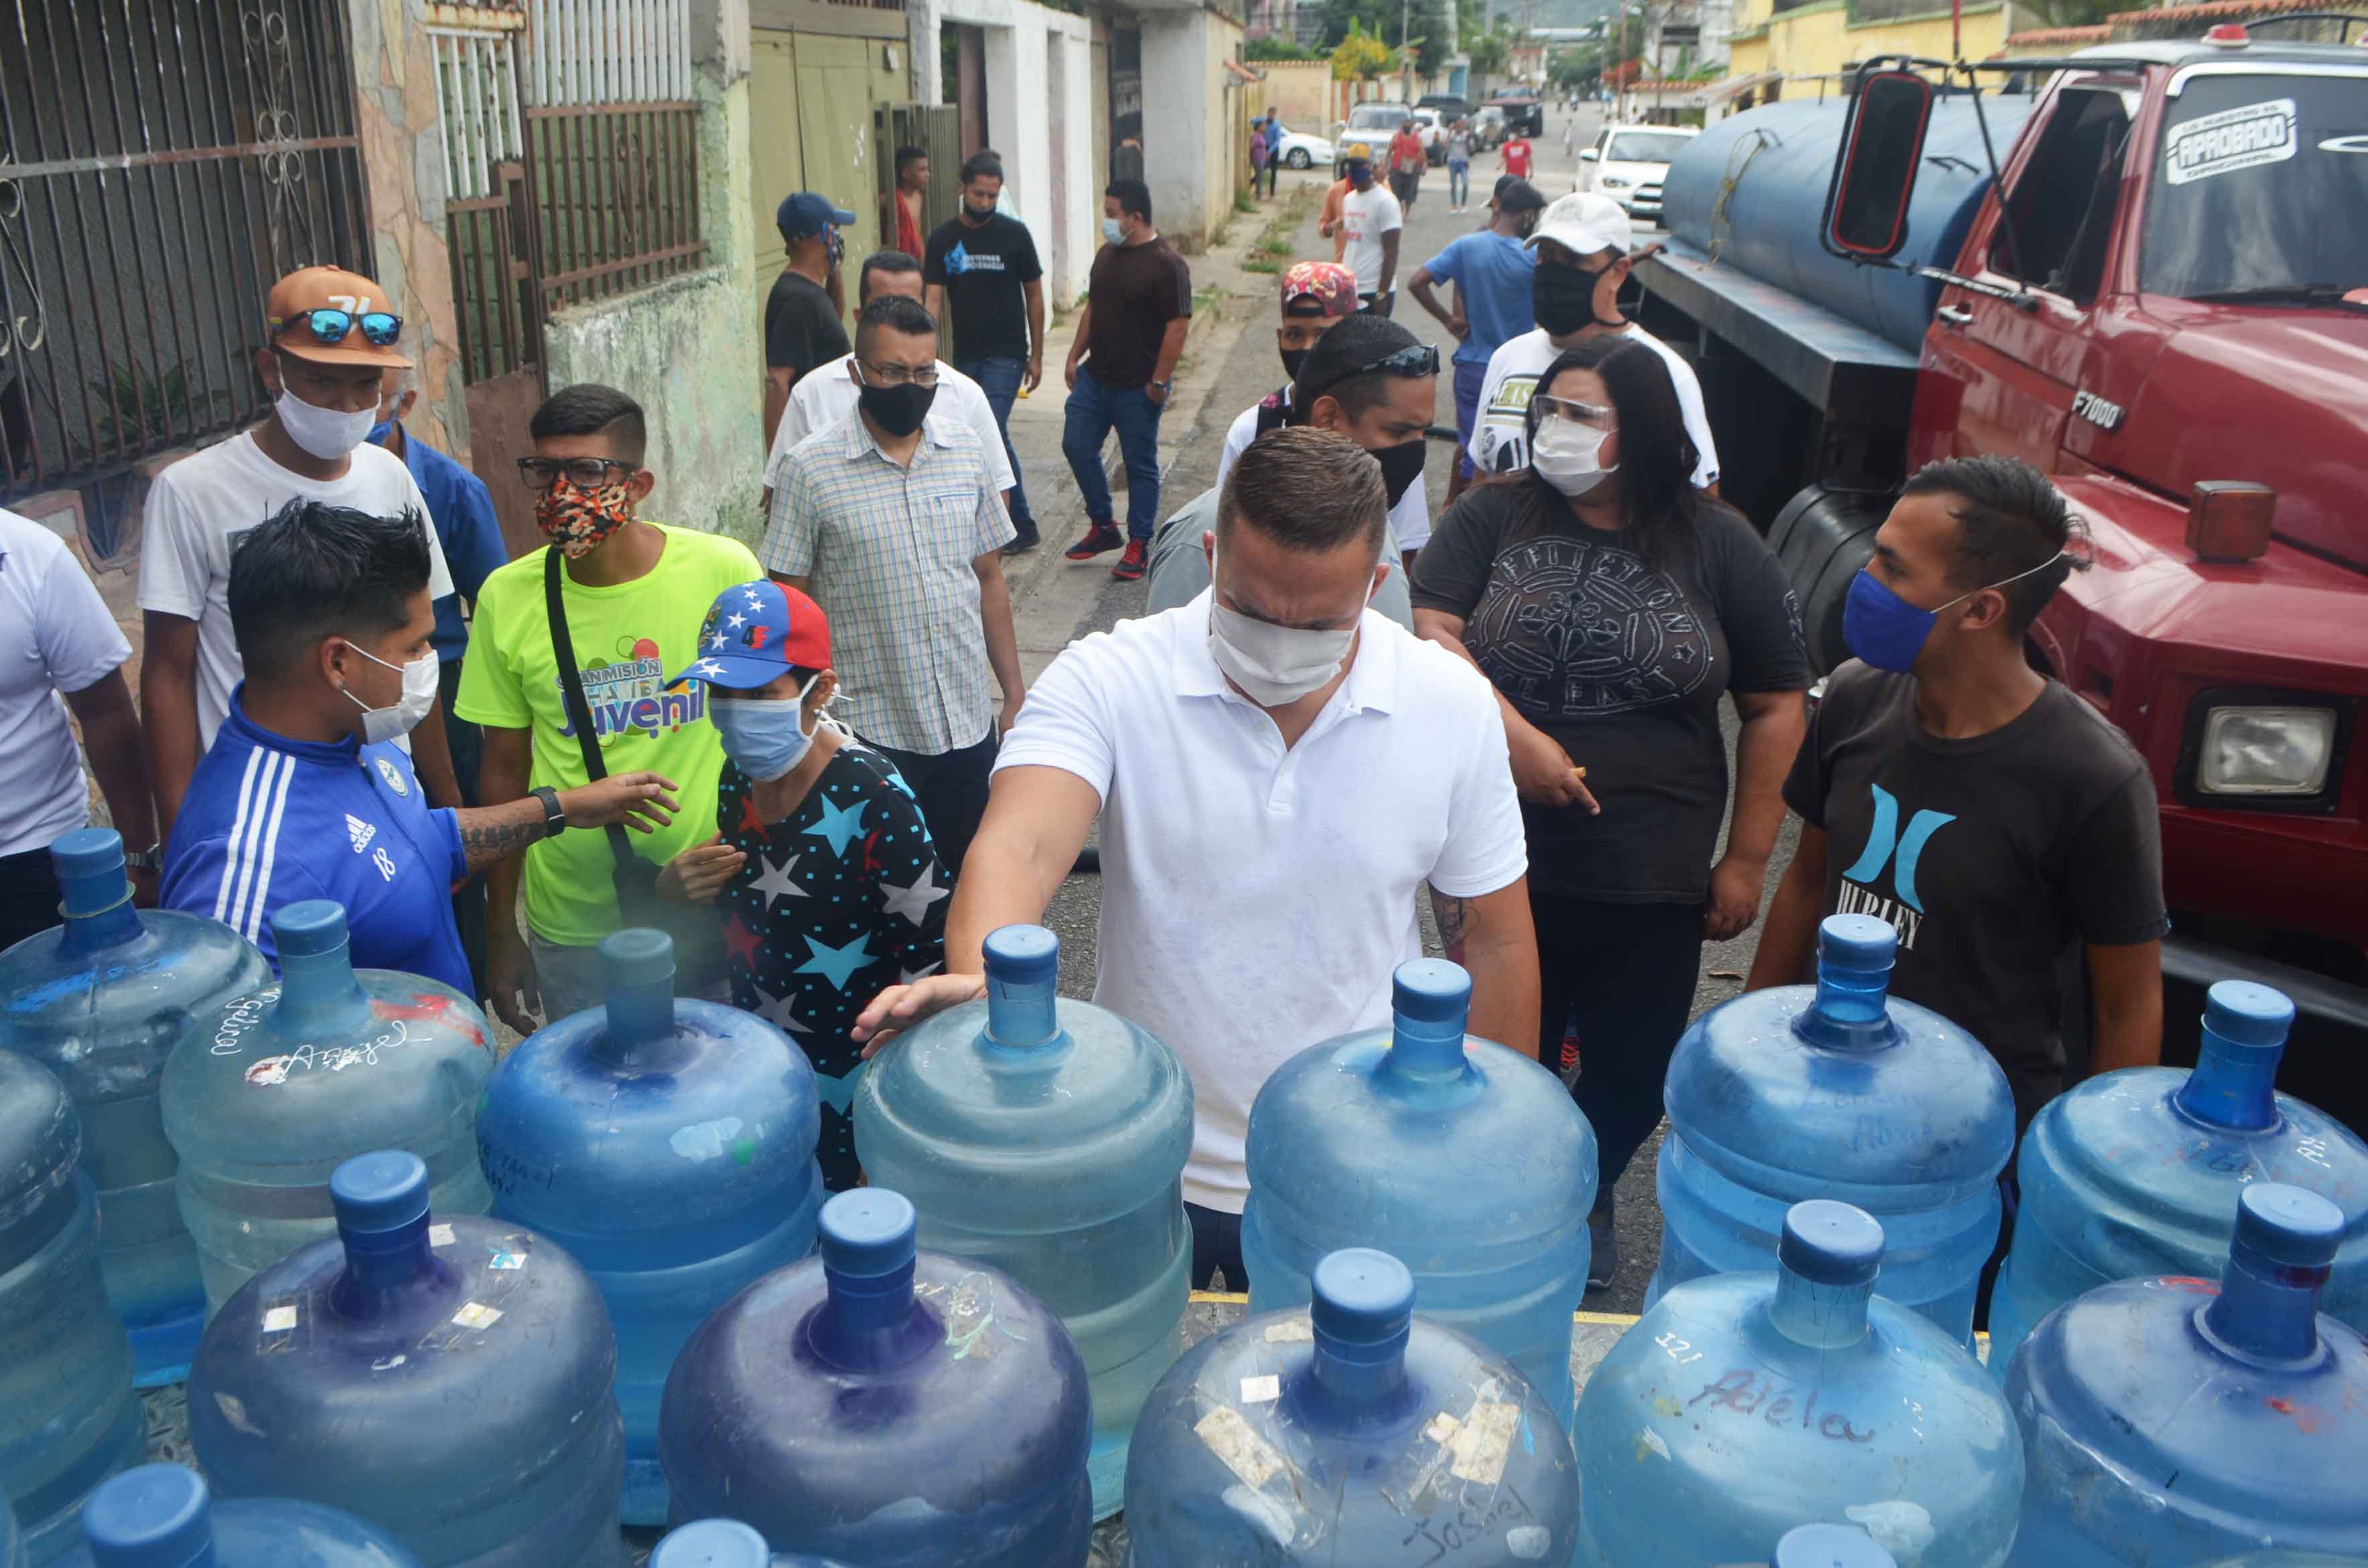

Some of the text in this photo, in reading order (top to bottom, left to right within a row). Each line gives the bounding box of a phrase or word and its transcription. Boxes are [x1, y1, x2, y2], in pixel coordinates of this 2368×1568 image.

[2178, 114, 2287, 167] APROBADO
[2071, 391, 2120, 428] F7000
[605, 656, 662, 682] MISIÓN
[354, 824, 376, 854] adidas
[372, 847, 396, 882] 18
